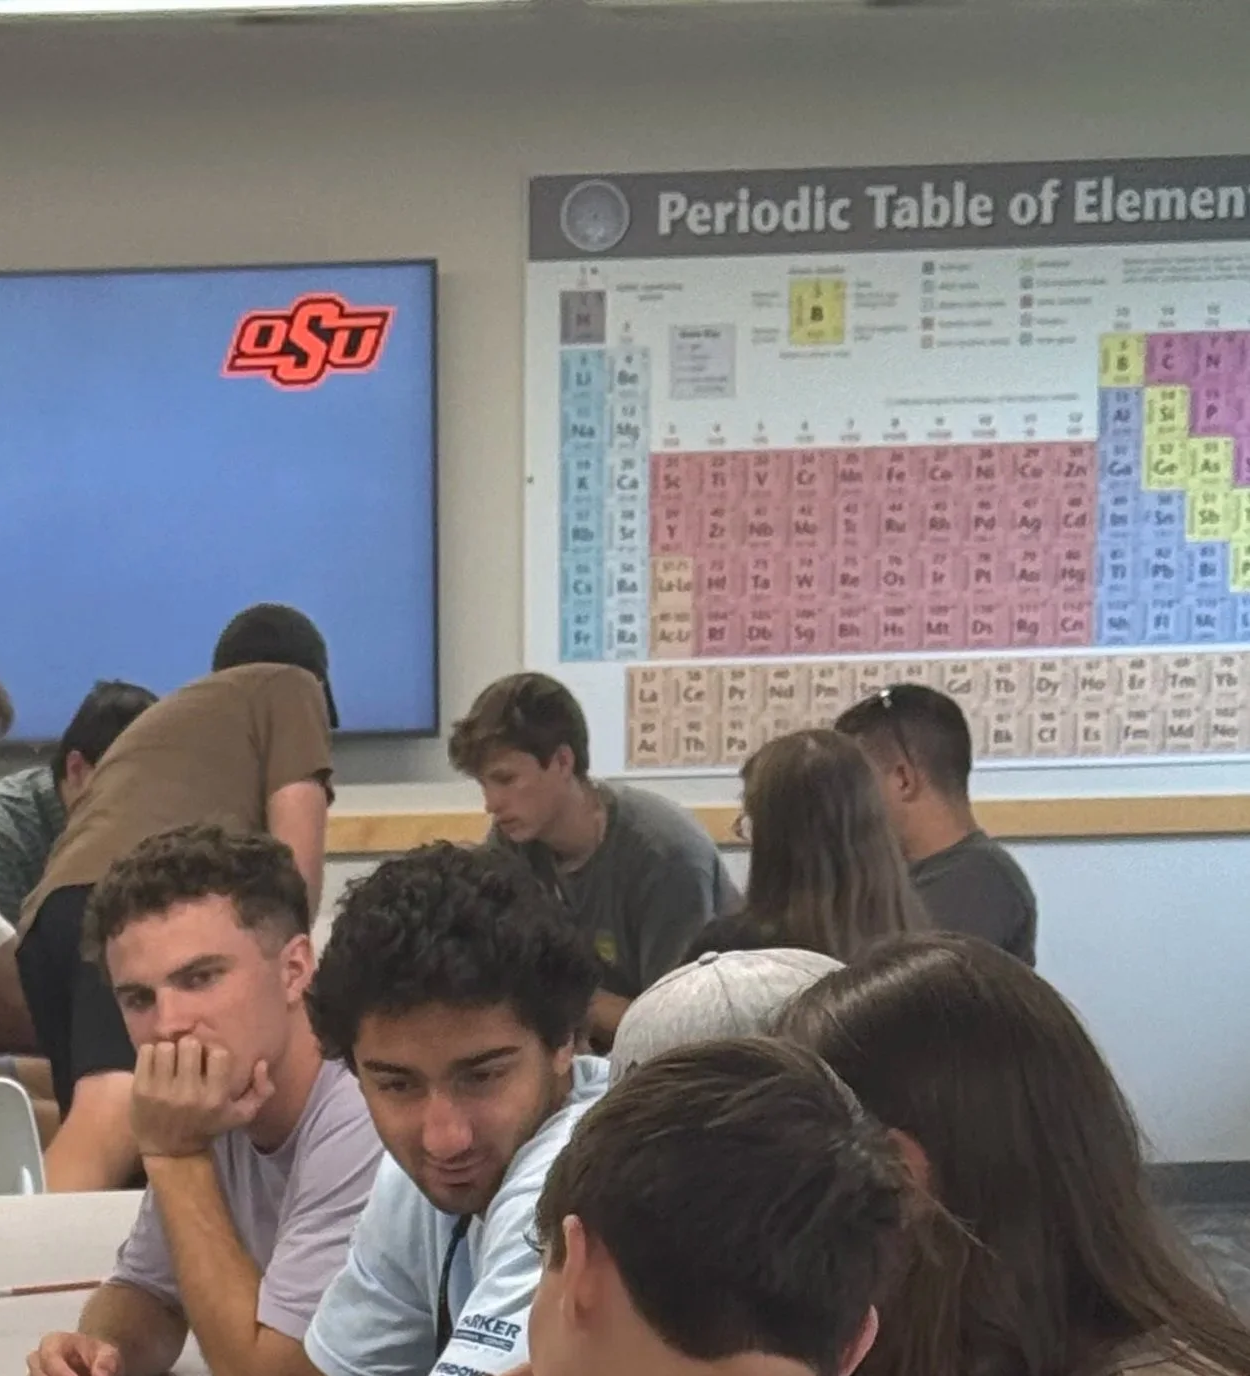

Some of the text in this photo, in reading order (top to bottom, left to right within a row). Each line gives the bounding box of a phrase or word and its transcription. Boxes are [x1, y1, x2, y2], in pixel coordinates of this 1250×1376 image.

[658, 176, 1250, 235] Periodic Table of Elemen
[227, 297, 391, 386] OSU
[1162, 354, 1174, 370] C
[1206, 404, 1217, 419] P
[577, 477, 588, 490] K
[617, 475, 638, 490] Ca
[755, 473, 767, 486] V
[797, 470, 815, 485] Cr
[1065, 462, 1086, 477] Zn
[666, 525, 677, 539] Y
[1063, 513, 1086, 528] Cd
[797, 575, 813, 588] W
[639, 689, 658, 703] La
[683, 687, 705, 701] Ce
[770, 685, 794, 699] Nd
[1036, 678, 1061, 696] Dy
[1038, 728, 1057, 742] Cf
